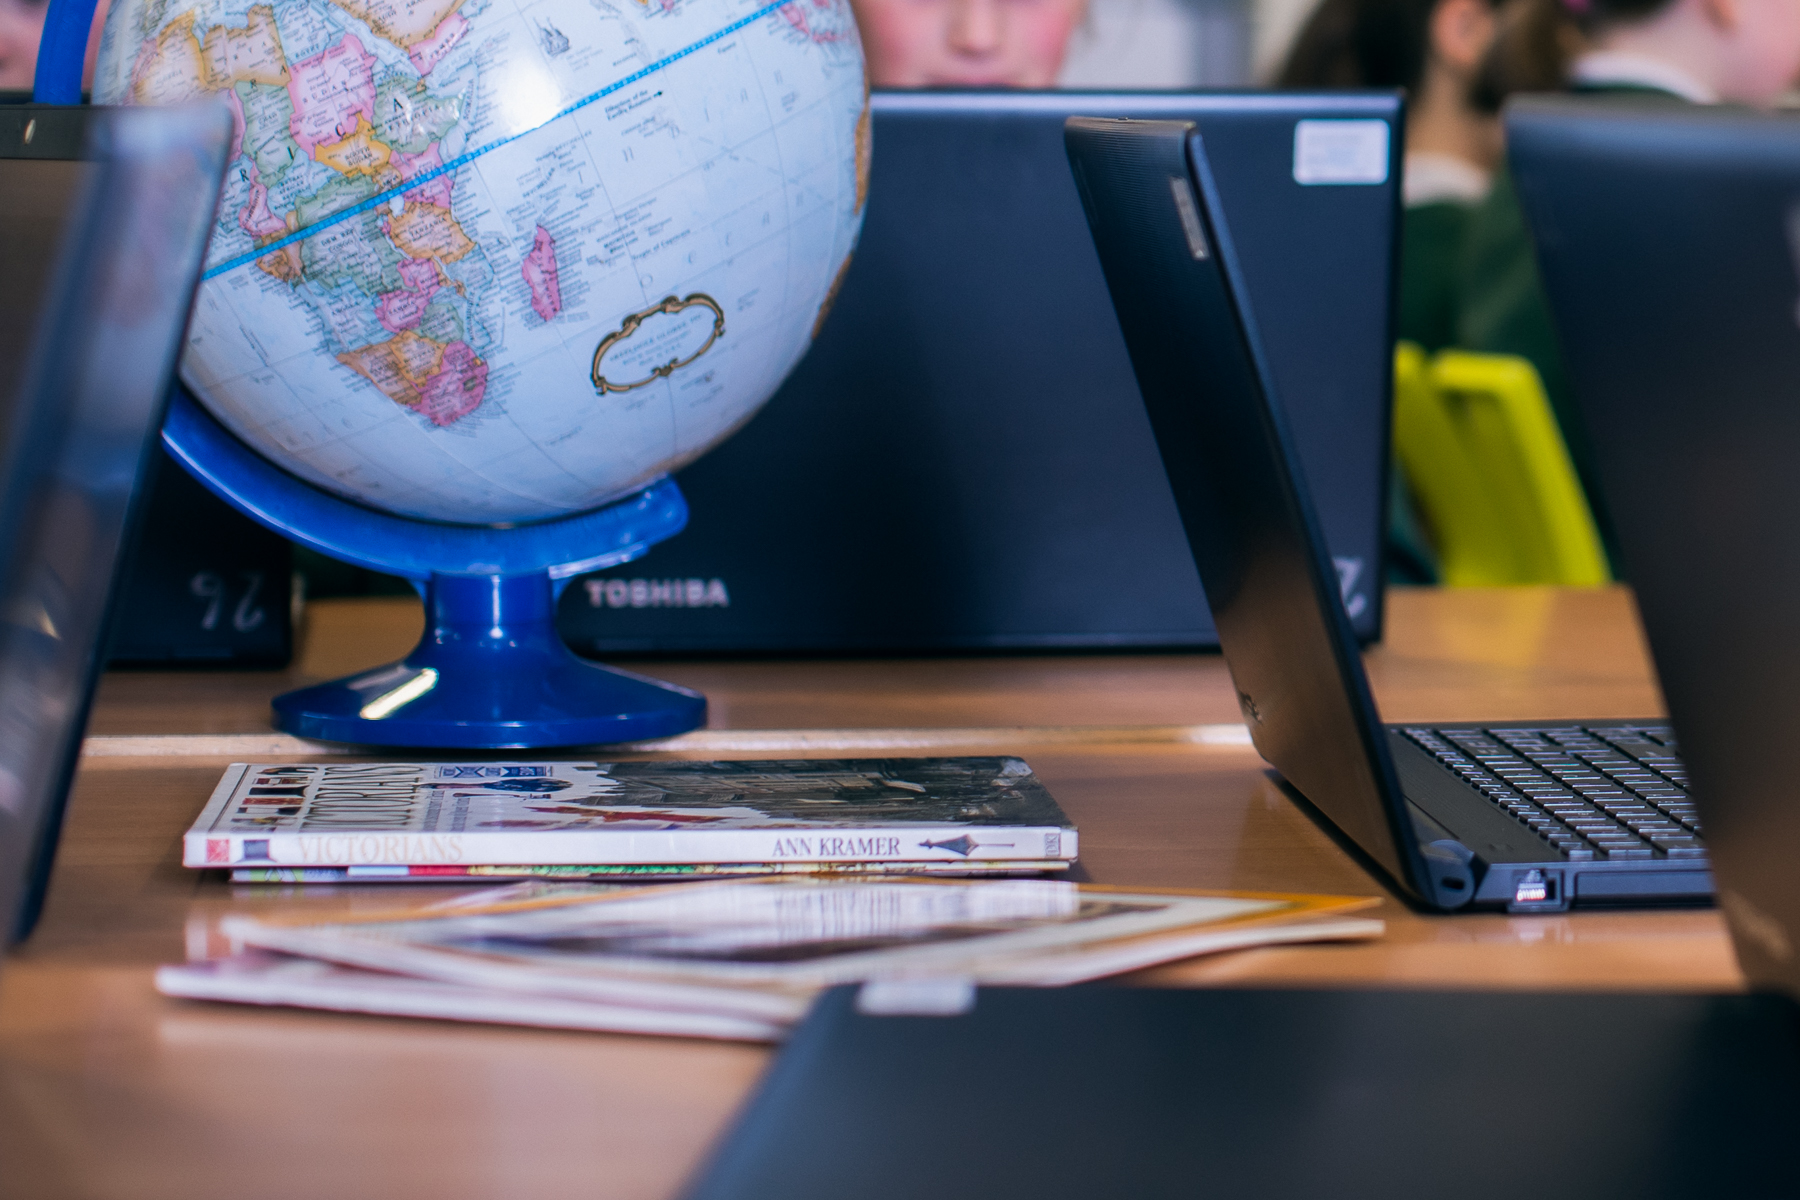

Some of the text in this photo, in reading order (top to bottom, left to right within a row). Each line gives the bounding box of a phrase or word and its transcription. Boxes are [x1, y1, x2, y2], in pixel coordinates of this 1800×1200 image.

[584, 577, 731, 608] TOSHIBA
[298, 835, 464, 863] VICTORIANS
[772, 837, 812, 857] ANN
[819, 836, 901, 857] KRAMER
